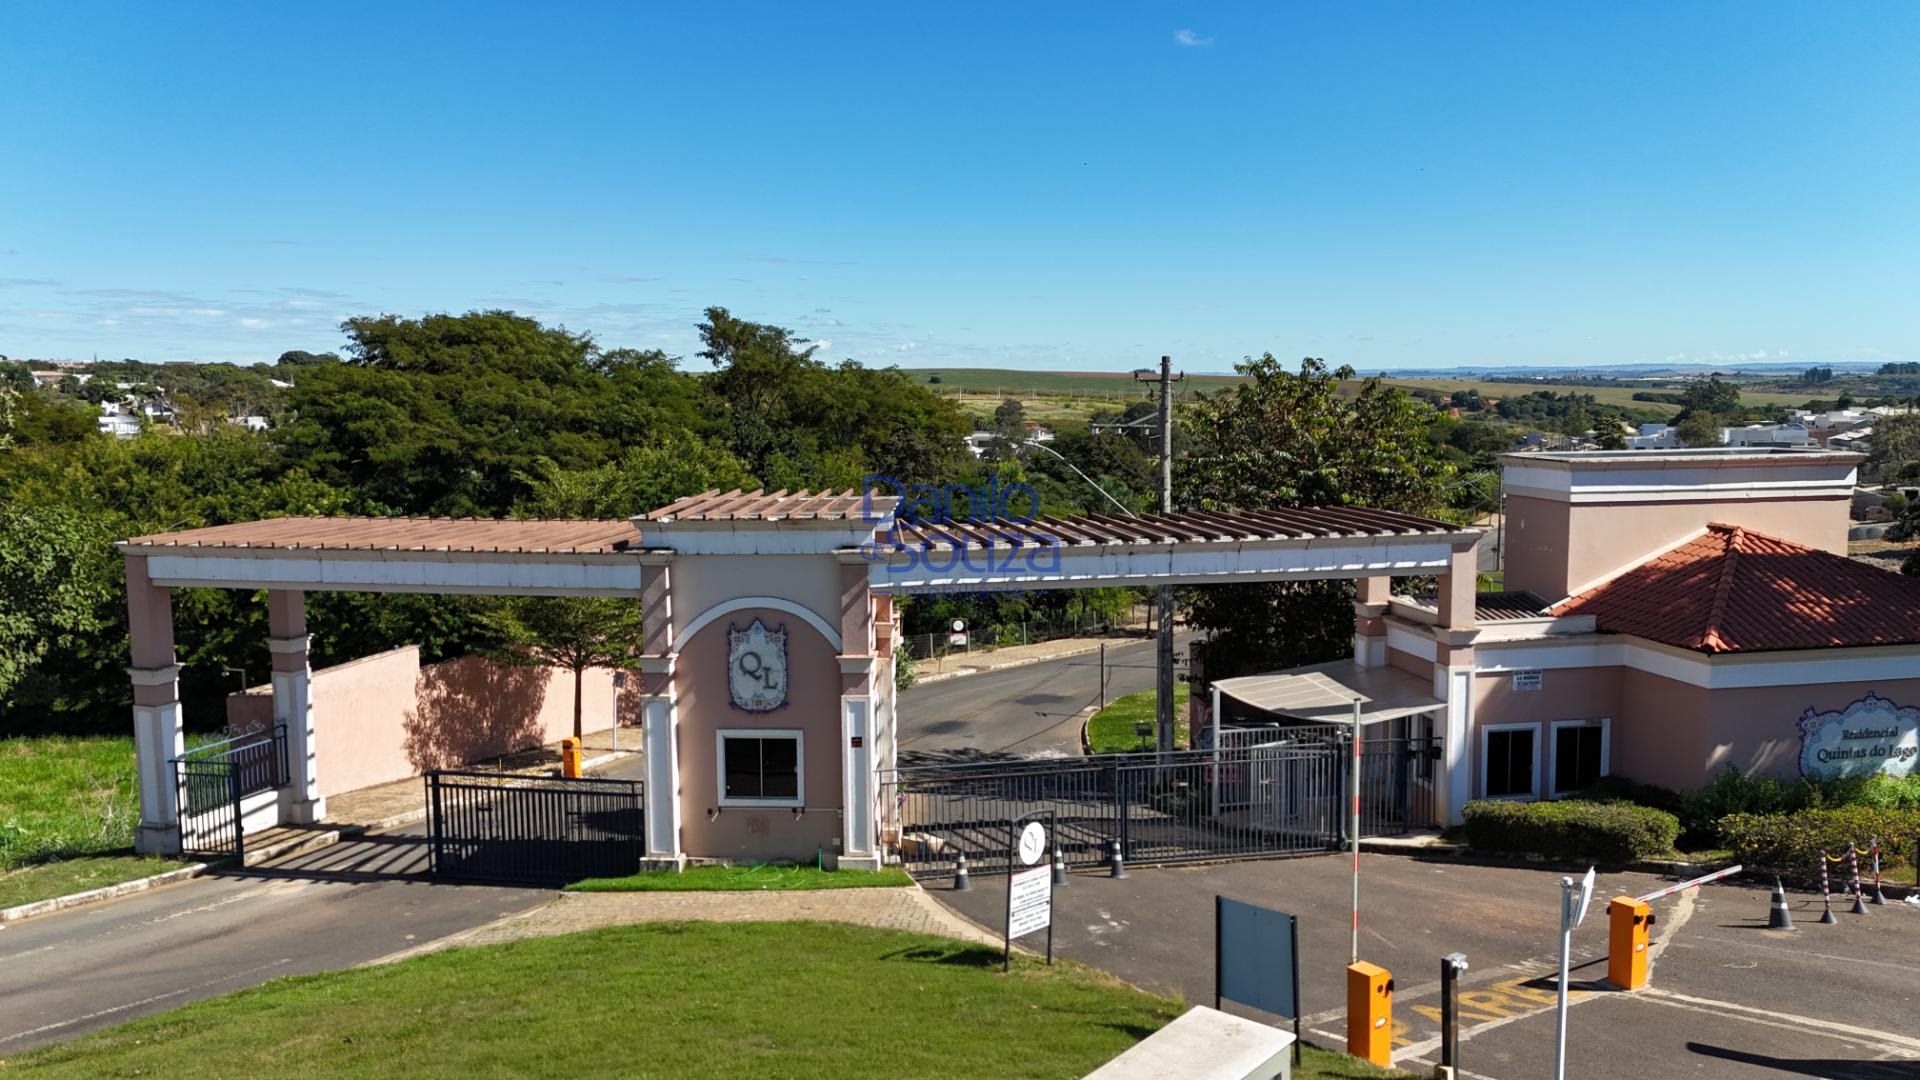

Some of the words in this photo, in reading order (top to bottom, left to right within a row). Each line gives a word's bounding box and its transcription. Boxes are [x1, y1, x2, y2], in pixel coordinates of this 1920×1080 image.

[1842, 726, 1899, 740] Residencial
[1817, 746, 1867, 763] Quintas
[1869, 745, 1886, 757] do
[1888, 744, 1918, 762] Lago
